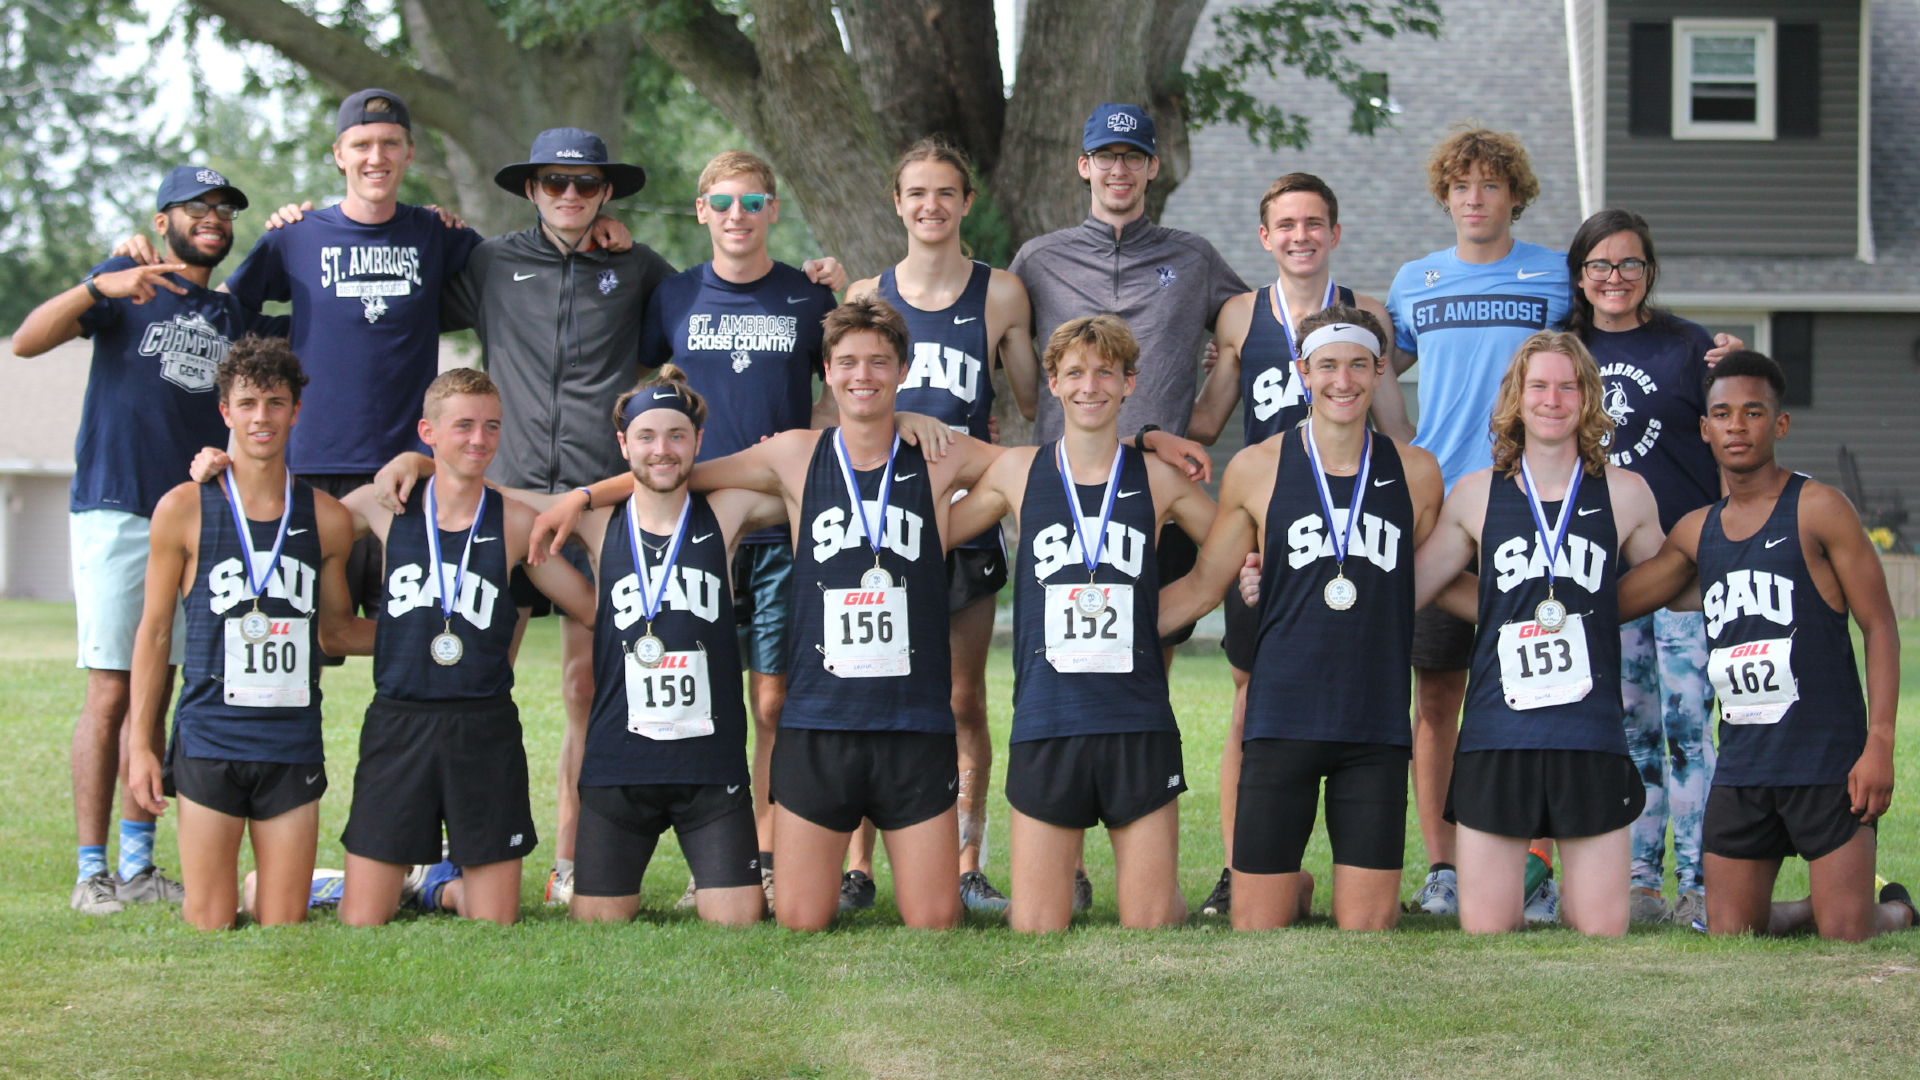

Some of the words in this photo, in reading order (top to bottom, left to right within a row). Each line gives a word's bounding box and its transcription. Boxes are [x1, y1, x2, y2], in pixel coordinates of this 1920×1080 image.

[1107, 112, 1137, 130] SAU
[321, 246, 346, 288] ST.
[349, 246, 422, 286] AMBROSE
[688, 314, 714, 335] ST.
[718, 314, 797, 337] AMBROSE
[1416, 305, 1440, 327] ST.
[1444, 301, 1543, 323] AMBROSE
[142, 325, 231, 364] CHAMPION
[687, 335, 733, 350] CROSS
[734, 335, 796, 352] COUNTRY
[896, 342, 981, 403] AU
[1253, 361, 1304, 421] SA
[1600, 362, 1658, 395] MBROSE
[1634, 418, 1662, 457] BEES
[812, 500, 923, 564] SAU
[1033, 516, 1146, 580] SAU
[1287, 508, 1401, 573] SAU
[1494, 530, 1607, 594] SAU
[208, 551, 316, 615] SAU
[387, 562, 499, 630] SAU
[611, 565, 721, 631] SAU
[843, 592, 886, 605] GILL
[1703, 569, 1794, 640] SAU
[840, 611, 893, 644] 156
[244, 641, 296, 674] 160
[653, 655, 688, 669] ILL
[1516, 639, 1573, 678] 153
[1730, 643, 1770, 658] GILL
[643, 675, 696, 708] 159
[1725, 660, 1780, 695] 162
